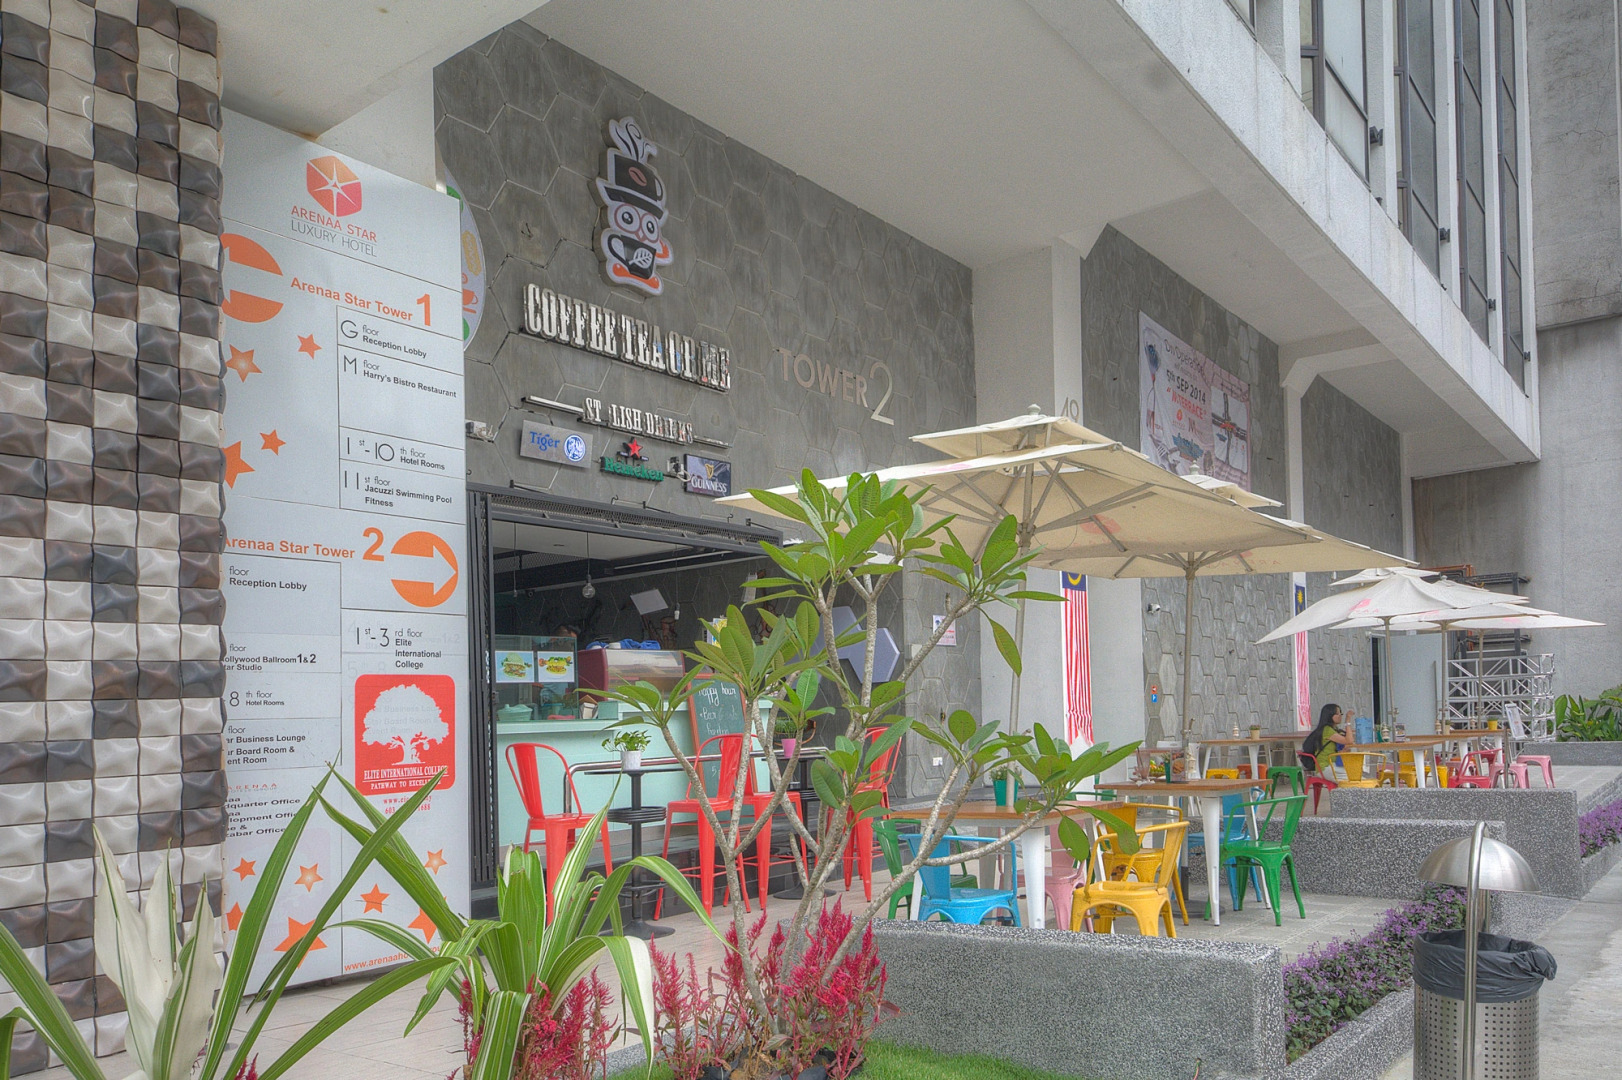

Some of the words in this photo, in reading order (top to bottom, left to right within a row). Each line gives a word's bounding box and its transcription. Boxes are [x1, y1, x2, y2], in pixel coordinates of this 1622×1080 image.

[291, 205, 342, 231] ARENAA
[347, 223, 377, 243] STAR
[291, 219, 337, 243] LUXURY
[341, 236, 377, 257] HOTEL
[290, 277, 340, 301] Arenaa
[344, 292, 371, 310] Star
[375, 300, 413, 321] Tower
[416, 293, 431, 327] 1
[340, 319, 359, 339] G
[362, 324, 379, 337] floor
[523, 283, 618, 357] COFFEE
[619, 314, 666, 372] TEA
[362, 335, 402, 351] Reception
[403, 346, 427, 360] Lobby
[343, 354, 358, 375] M
[363, 360, 380, 371] floor
[363, 370, 392, 384] Harry's
[393, 376, 416, 389] Bistro
[417, 382, 457, 398] Restaurant
[778, 348, 869, 408] TOWER
[869, 362, 894, 426] 2
[1176, 376, 1189, 393] SEP
[1190, 384, 1206, 405] 2014
[529, 431, 561, 452] Tiger
[410, 447, 426, 459] floor
[400, 456, 420, 467] Hotel
[420, 460, 445, 471] Rooms
[604, 457, 664, 481] Heineken
[374, 475, 391, 487] floor
[690, 477, 727, 493] GUINNESS
[364, 485, 394, 496] Jacuzzi
[395, 489, 435, 503] Swimming
[436, 494, 453, 505] Pool
[365, 497, 394, 508] Fitness
[279, 540, 310, 554] Star
[313, 543, 356, 559] Tower
[362, 527, 385, 562] 2
[229, 565, 250, 576] floor
[229, 577, 277, 589] Reception
[279, 581, 307, 592] Lobby
[380, 628, 390, 647] 3
[407, 628, 423, 638] floor
[395, 639, 413, 647] Elite
[230, 644, 247, 652] floor
[395, 649, 442, 658] International
[223, 656, 261, 664] ollywood
[262, 656, 297, 664] Ballroom
[395, 660, 424, 670] College
[256, 690, 273, 698] floor
[228, 725, 246, 734] floor
[236, 736, 275, 744] Business
[276, 735, 306, 744] Lounge
[236, 747, 261, 756] Board
[263, 746, 287, 754] Room
[363, 769, 380, 780] ELITE
[380, 766, 423, 778] INTERNATIONAL
[371, 782, 397, 790] PATHWAY
[225, 801, 269, 809] dquarter
[229, 814, 273, 823] lopment
